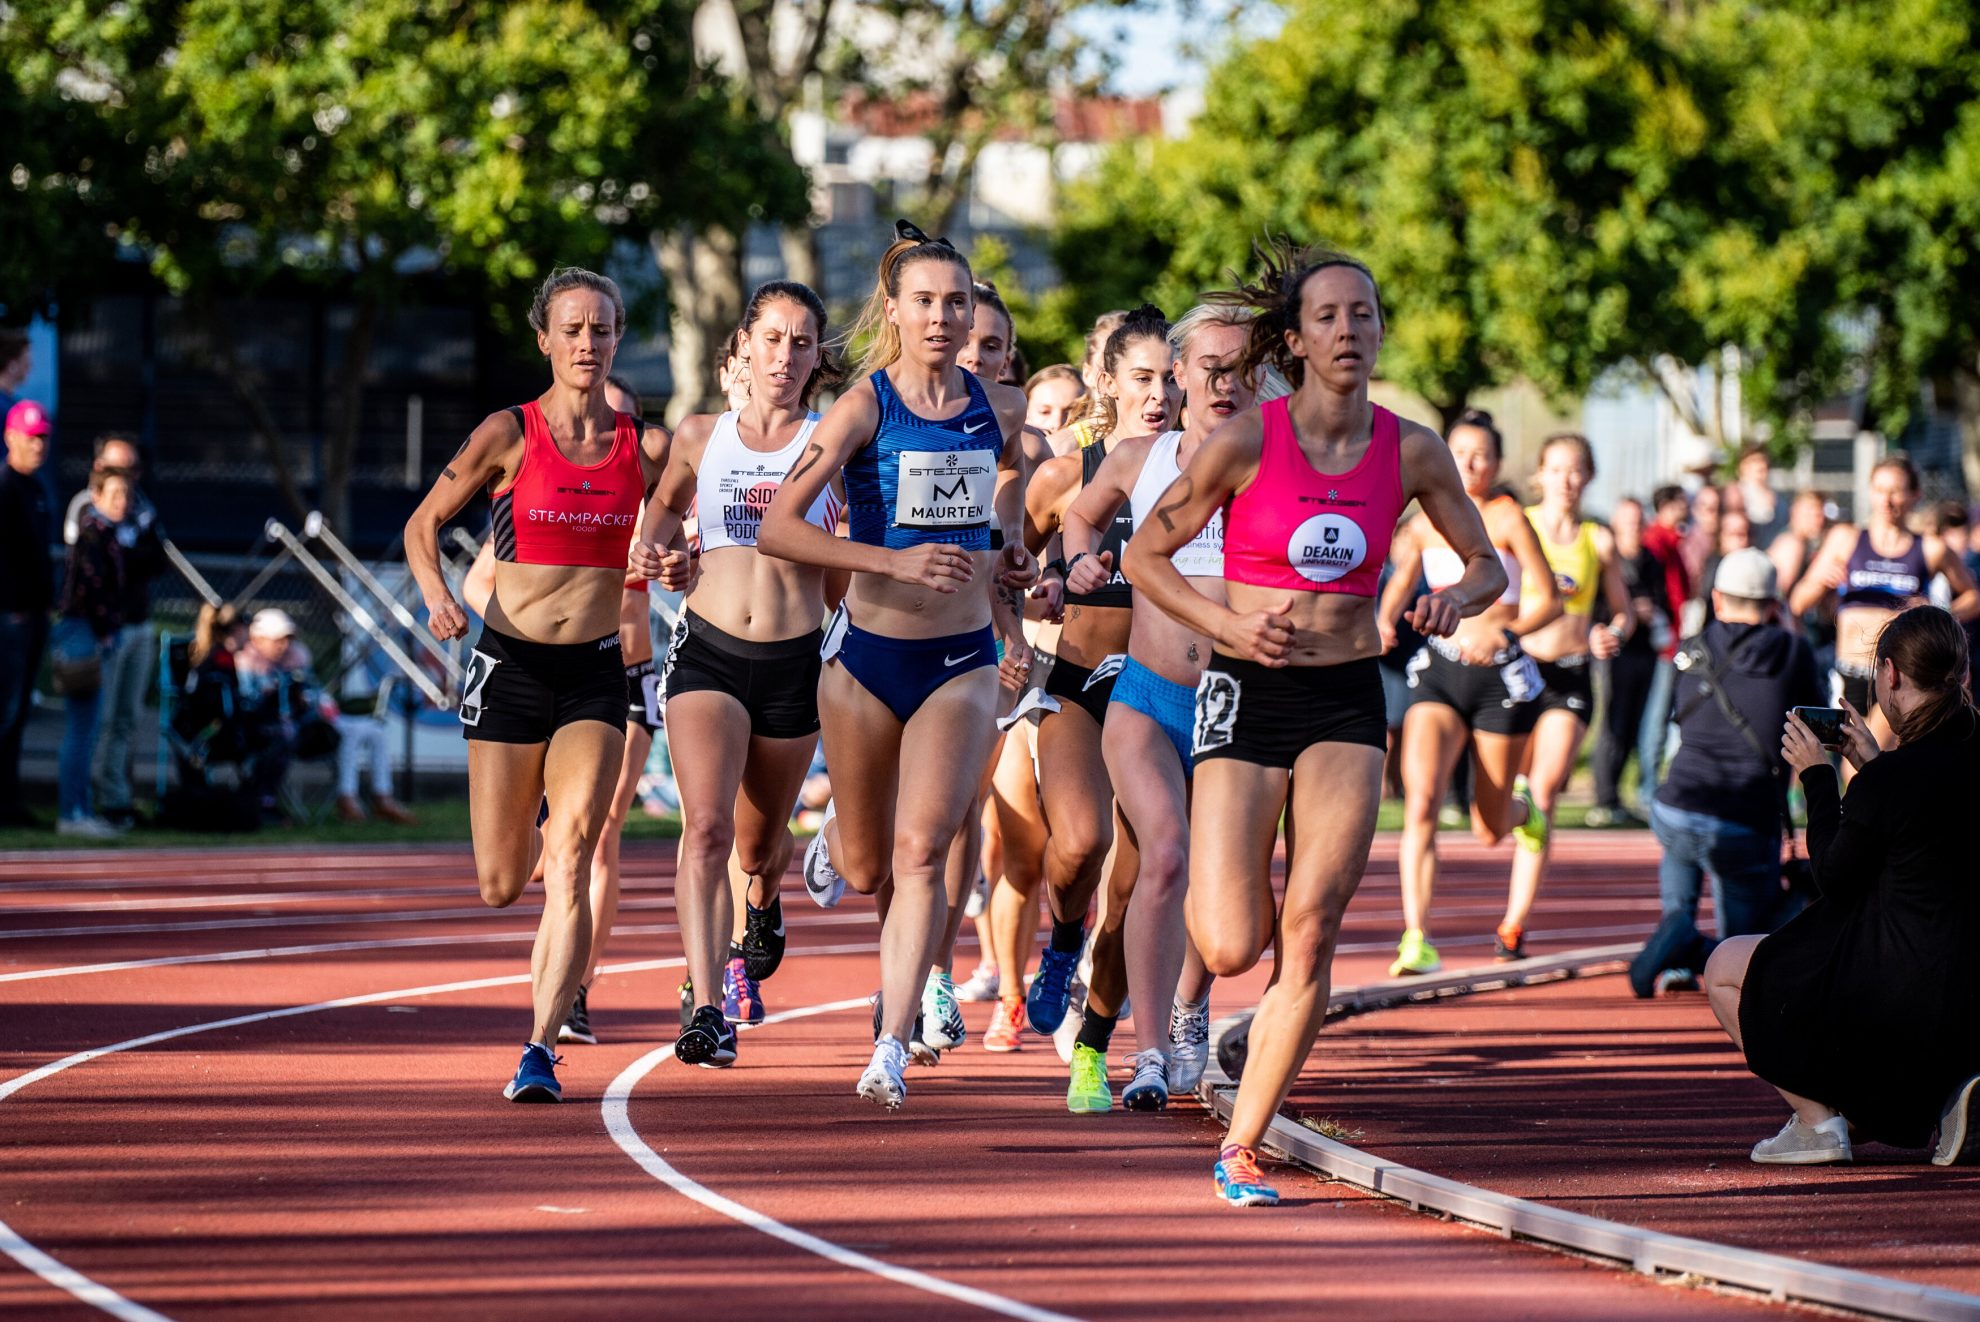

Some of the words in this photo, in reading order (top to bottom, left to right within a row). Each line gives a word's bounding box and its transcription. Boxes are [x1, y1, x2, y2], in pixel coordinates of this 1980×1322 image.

[909, 466, 990, 476] STEIGEN
[528, 509, 635, 527] STEAMPACKET
[911, 505, 984, 519] MAURTEN
[726, 523, 760, 540] PODC
[1303, 546, 1354, 561] DEAKIN
[1301, 558, 1351, 568] UNIVERSITY
